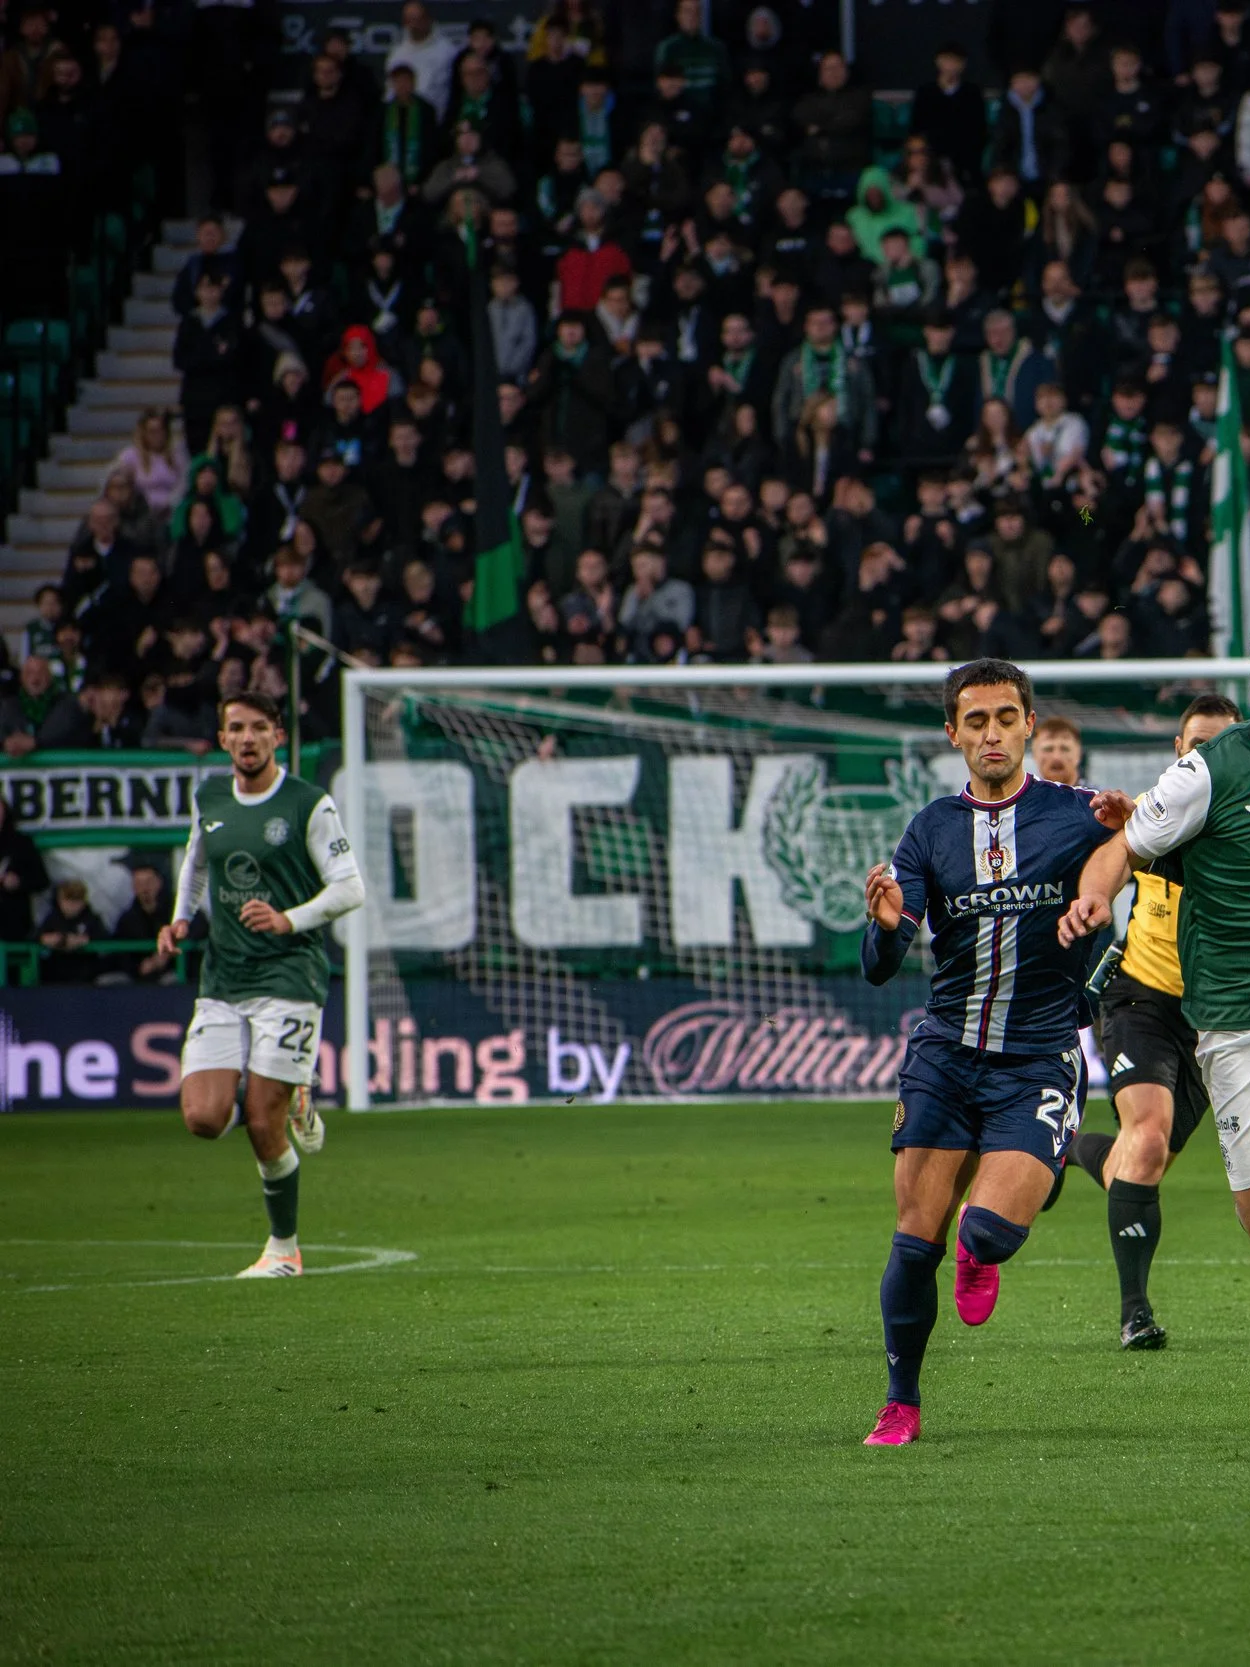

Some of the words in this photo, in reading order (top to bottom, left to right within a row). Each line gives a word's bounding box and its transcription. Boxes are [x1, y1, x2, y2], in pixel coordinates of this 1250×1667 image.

[954, 880, 1063, 910] CROWN
[1002, 901, 1034, 911] services
[278, 1018, 314, 1054] 22
[547, 1026, 631, 1102] by
